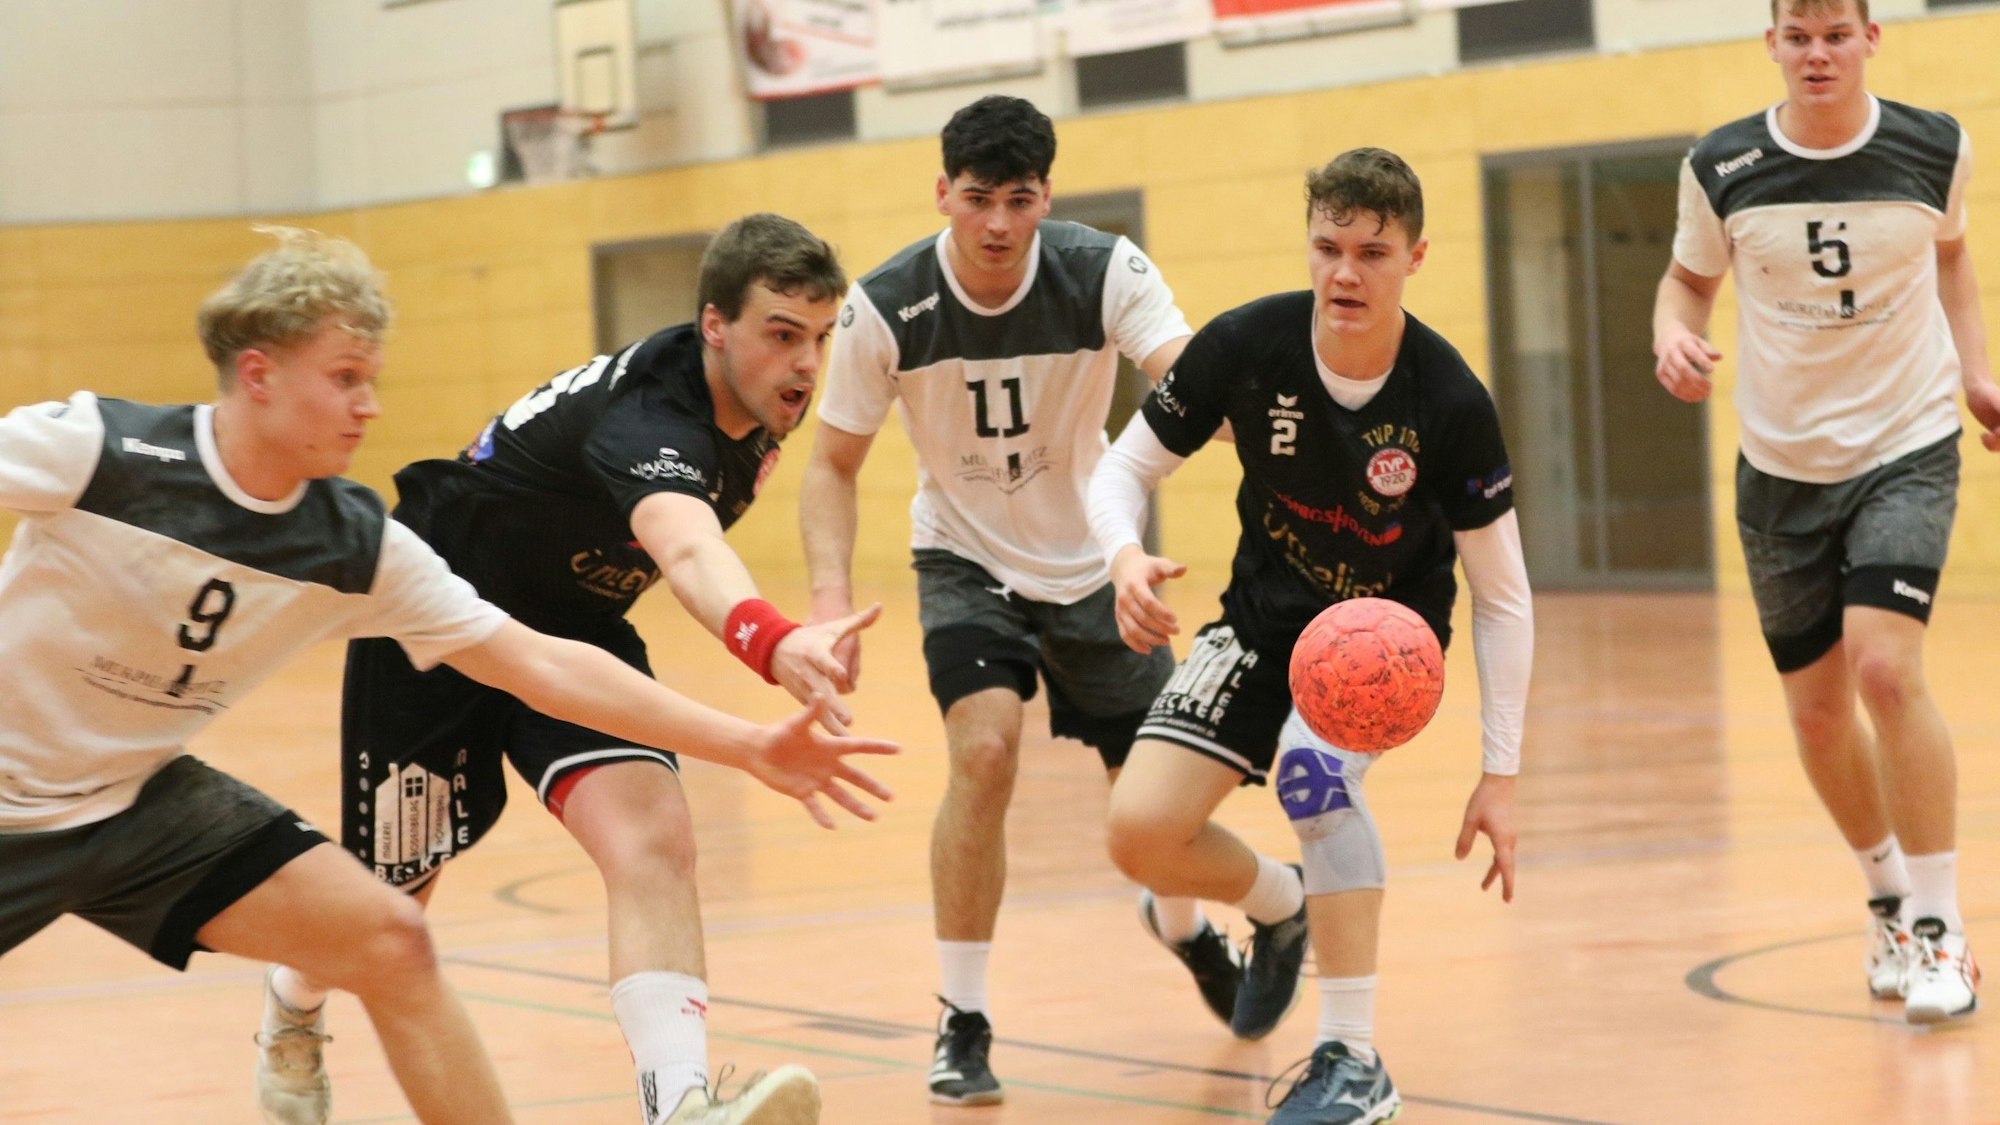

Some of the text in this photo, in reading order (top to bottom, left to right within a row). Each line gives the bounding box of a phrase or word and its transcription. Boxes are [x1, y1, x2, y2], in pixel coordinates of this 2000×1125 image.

[1714, 148, 1763, 177] Kempa
[1807, 221, 1852, 278] 5
[966, 378, 1029, 438] 11
[1268, 408, 1304, 420] erima
[1271, 419, 1297, 456] 2
[1362, 424, 1393, 448] TVP
[1377, 457, 1404, 474] TVP
[1381, 472, 1406, 487] 1920
[177, 578, 236, 652] 9
